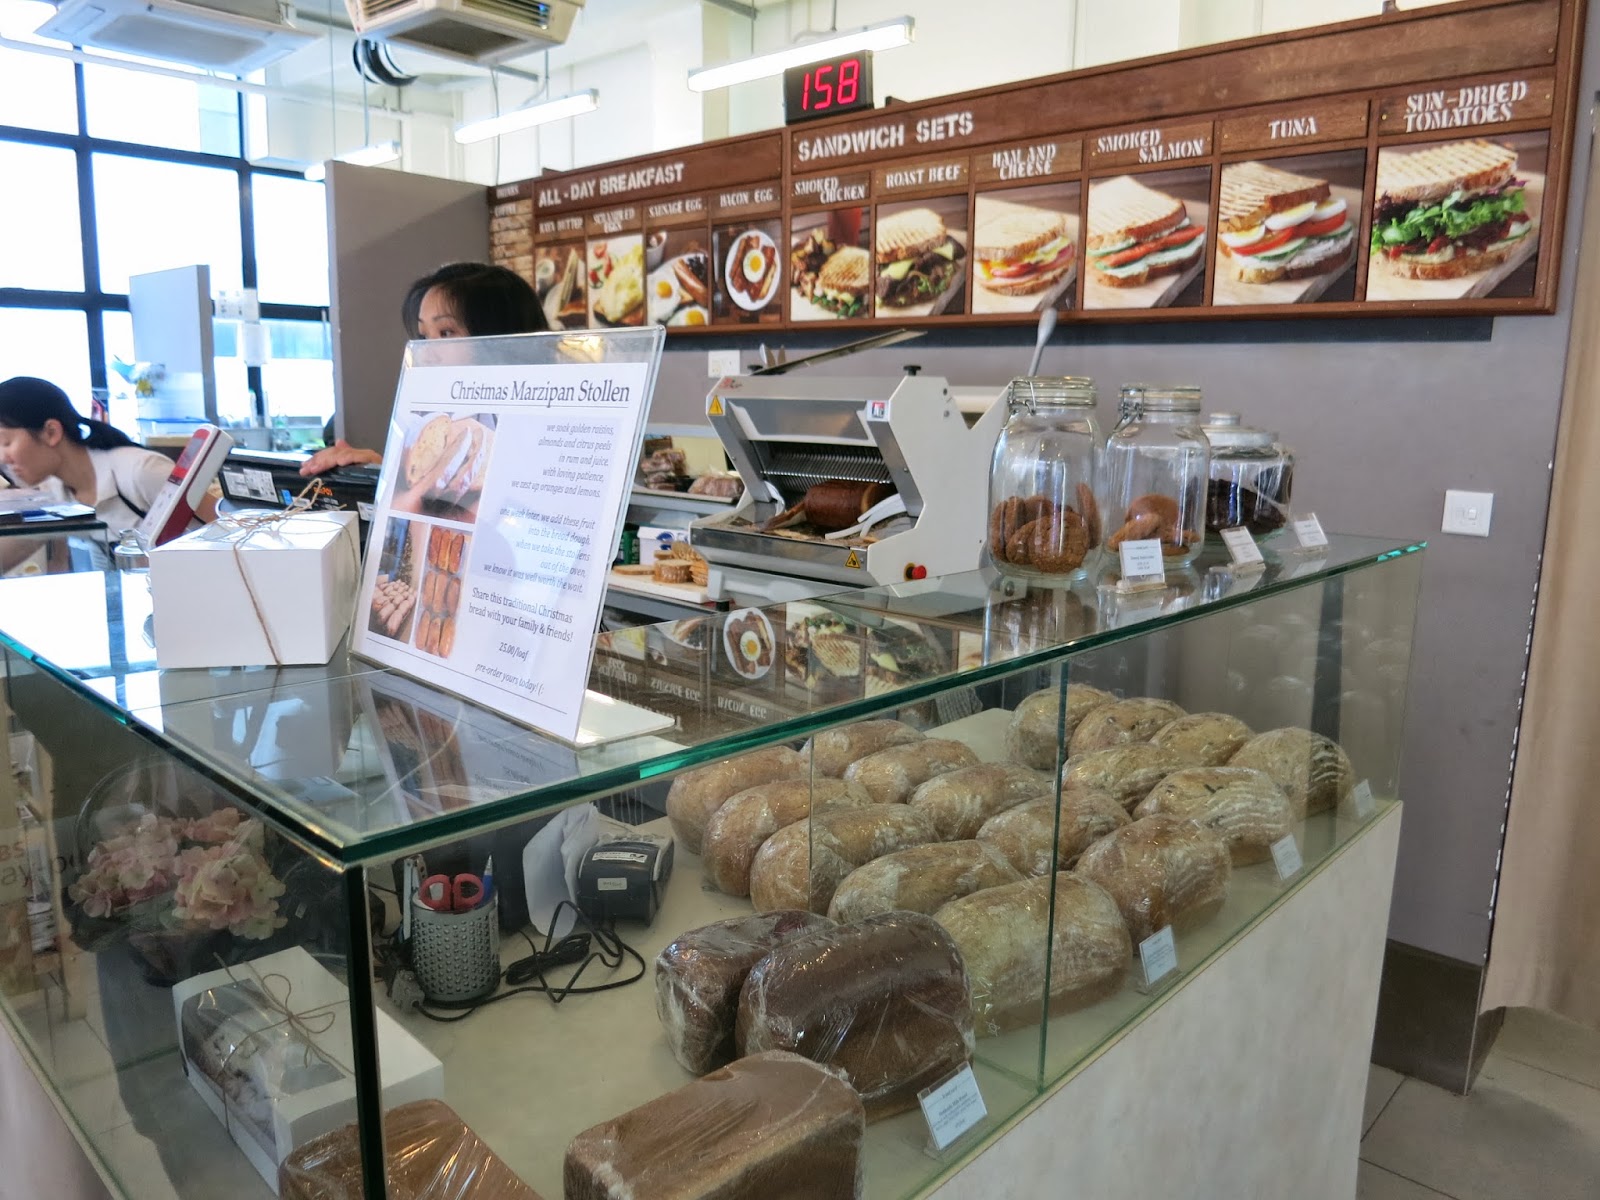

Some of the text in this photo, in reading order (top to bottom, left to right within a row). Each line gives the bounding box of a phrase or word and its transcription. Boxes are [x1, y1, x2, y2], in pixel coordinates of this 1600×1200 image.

[802, 59, 860, 112] 158
[1268, 117, 1317, 139] TUNA
[1404, 102, 1513, 133] TOMATOES
[798, 112, 973, 162] SANDWICH SETS
[1097, 129, 1161, 153] SMOKED
[992, 144, 1056, 168] HAM AND
[1138, 139, 1204, 164] SALMON
[600, 162, 684, 196] BREAKFAST
[886, 164, 961, 189] ROAST BEEF
[999, 159, 1052, 180] CHEESE
[795, 177, 839, 196] SMOKED
[820, 184, 866, 204] CHICKEN
[649, 198, 702, 218] SAUSAGE EGG
[720, 188, 773, 208] BACON EGG
[450, 379, 630, 408] Christmas Marzipan Stollen
[546, 424, 555, 432] we
[556, 422, 570, 433] soak
[570, 423, 591, 436] golden
[538, 437, 612, 452] almonds and citrus peels
[559, 454, 566, 463] in
[566, 456, 580, 465] rum
[580, 455, 592, 466] and
[542, 467, 556, 477] with
[557, 468, 576, 481] loving
[511, 480, 519, 488] we
[519, 480, 532, 490] zest
[532, 483, 540, 493] up
[540, 484, 563, 495] oranges
[564, 484, 577, 495] and
[541, 513, 551, 521] we
[551, 514, 562, 525] add
[563, 515, 579, 527] these
[579, 518, 596, 530] fruit
[528, 525, 540, 535] into
[540, 526, 552, 537] the
[552, 528, 570, 540] bread
[515, 539, 531, 550] when
[531, 543, 540, 552] we
[540, 543, 555, 555] take
[554, 546, 566, 557] the
[483, 563, 492, 572] we
[491, 563, 507, 575] know
[507, 567, 513, 577] it
[513, 568, 525, 579] was
[524, 570, 537, 582] well
[538, 573, 556, 587] worth
[556, 576, 567, 589] the
[540, 560, 551, 570] out
[551, 561, 559, 573] of
[559, 562, 570, 574] the
[472, 587, 573, 624] Share this traditional Christmas
[468, 602, 574, 643] bread with your family & friends!
[498, 641, 530, 662] 25.00/loaf
[475, 663, 503, 679] pre-order
[502, 672, 519, 685] yours
[519, 678, 539, 694] today!
